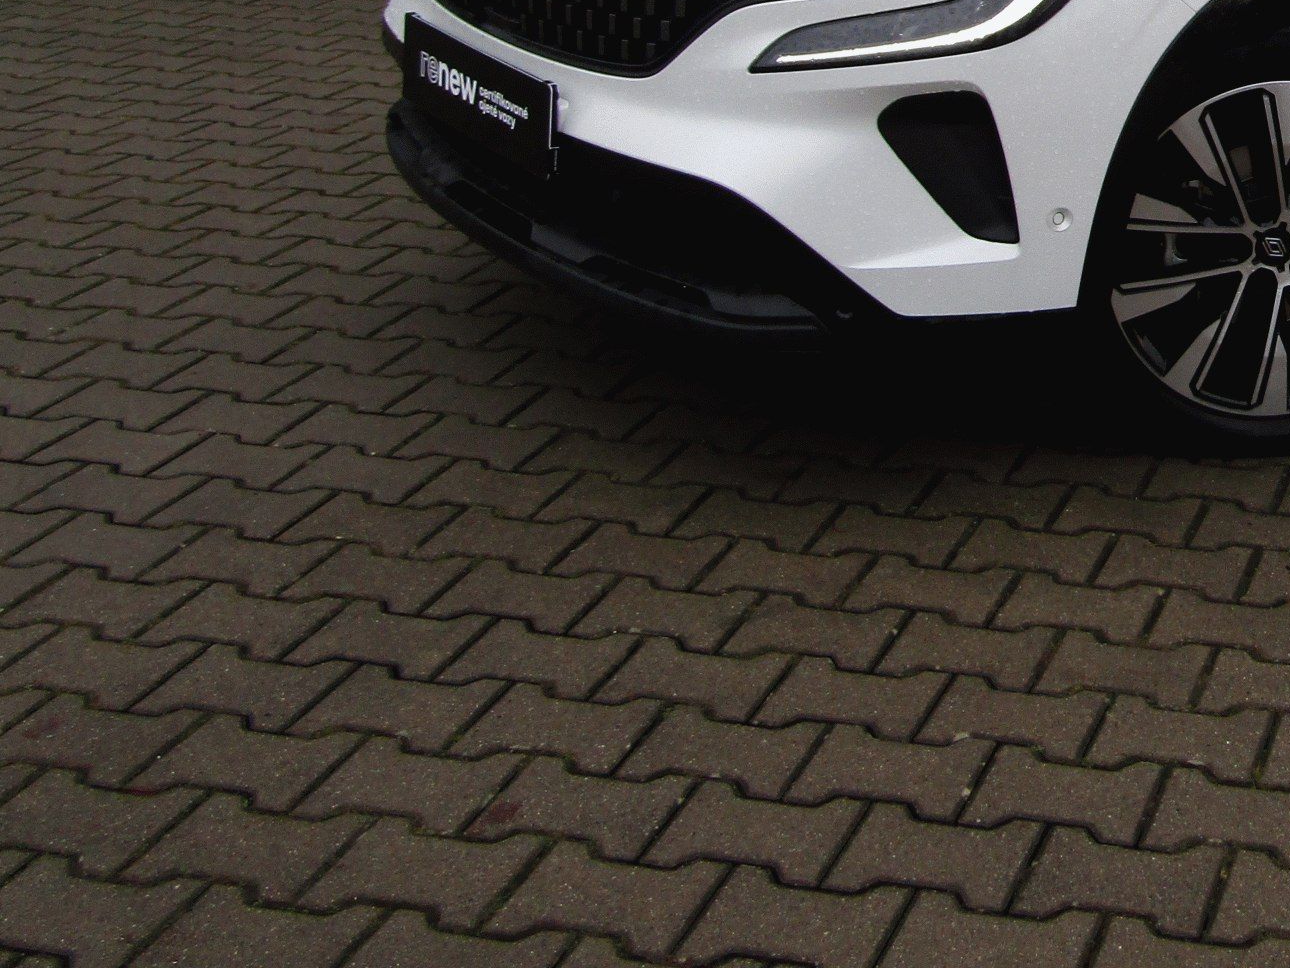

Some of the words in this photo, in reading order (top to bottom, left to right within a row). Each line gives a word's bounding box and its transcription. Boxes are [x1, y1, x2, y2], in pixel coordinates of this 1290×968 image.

[419, 50, 477, 105] renew
[479, 86, 529, 119] certifikované
[479, 99, 498, 118] ojeté
[498, 110, 516, 130] vozy
